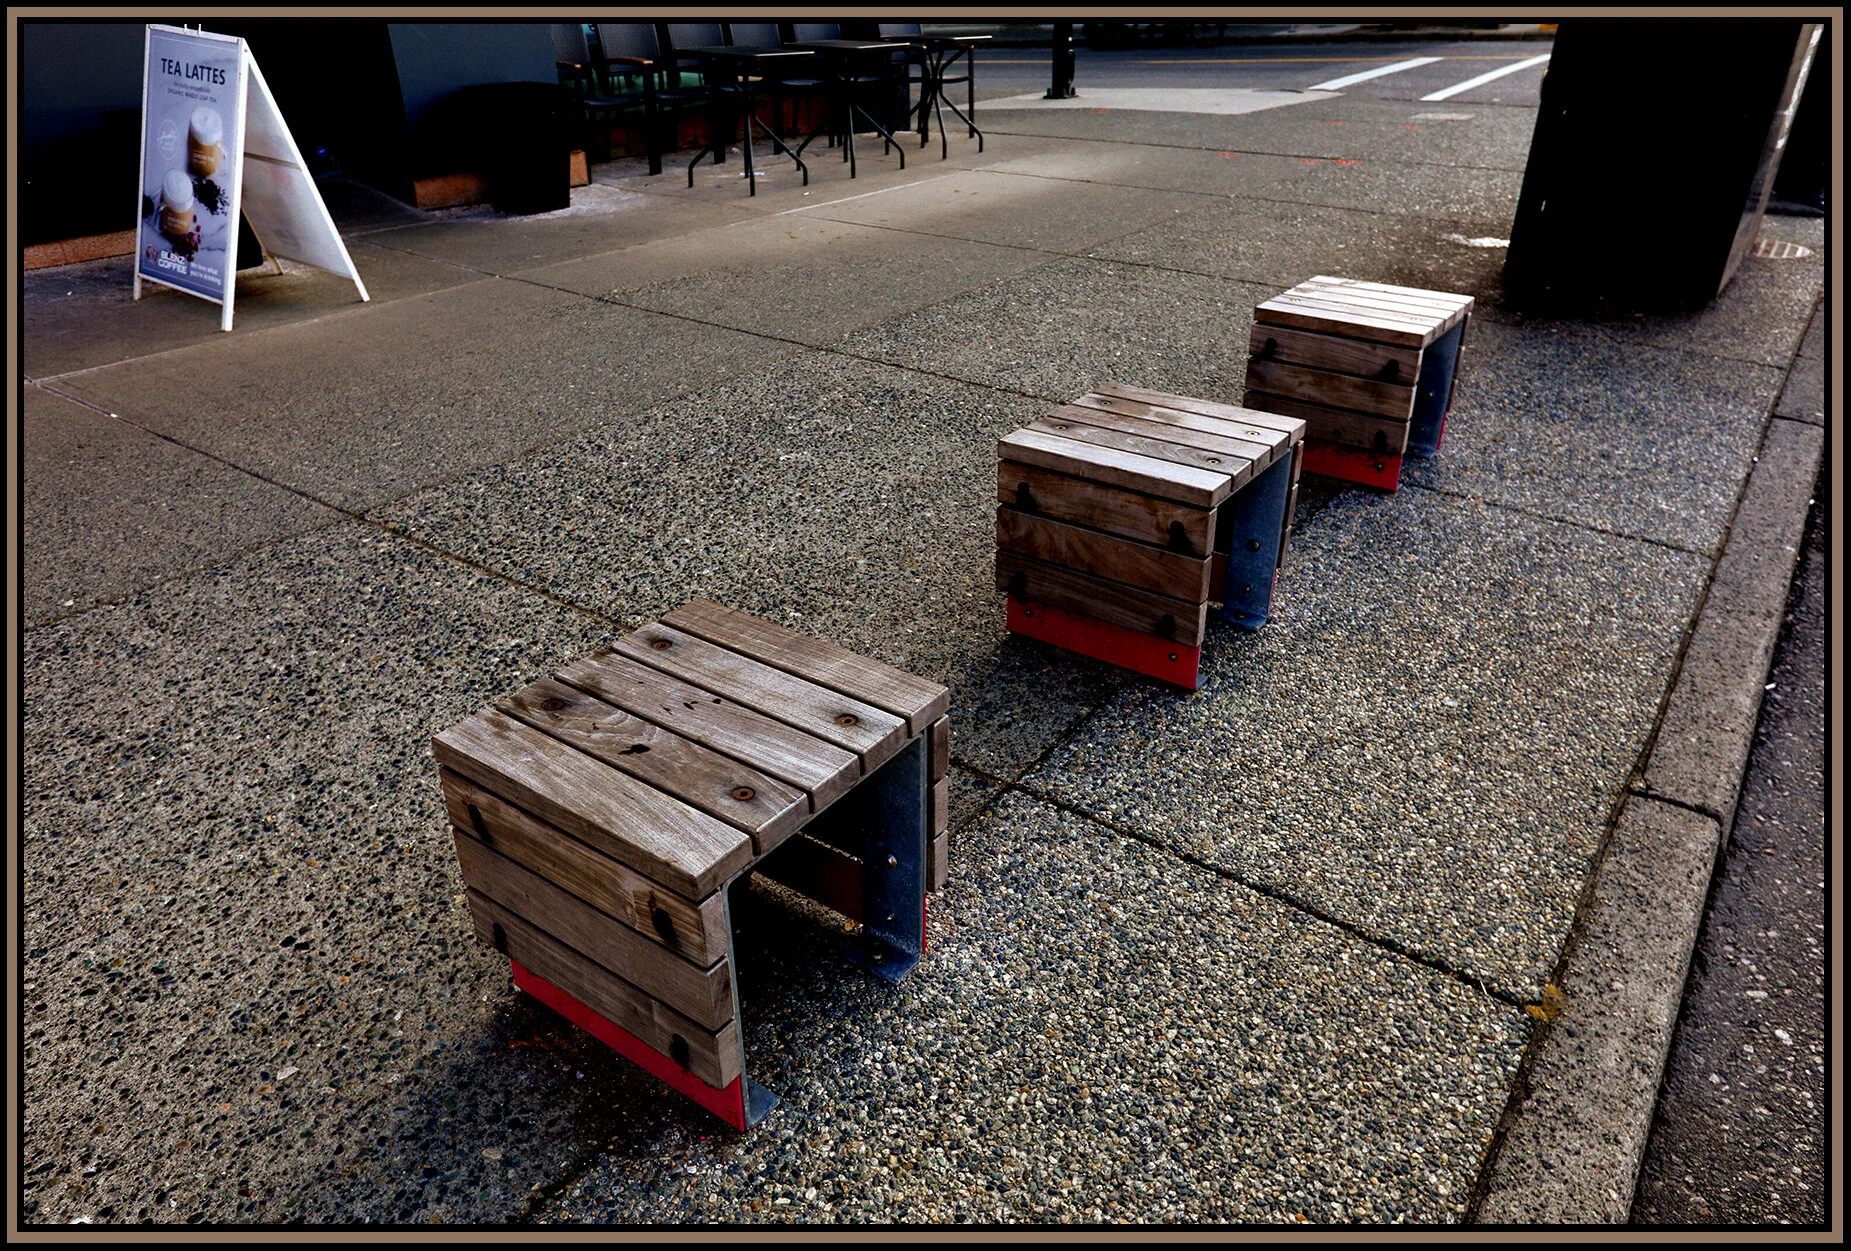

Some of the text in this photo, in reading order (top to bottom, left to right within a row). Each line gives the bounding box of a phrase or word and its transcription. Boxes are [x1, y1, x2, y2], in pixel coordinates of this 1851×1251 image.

[161, 58, 226, 85] TEA LATTES
[161, 250, 186, 264] BLENZ
[158, 258, 188, 275] COFFEE
